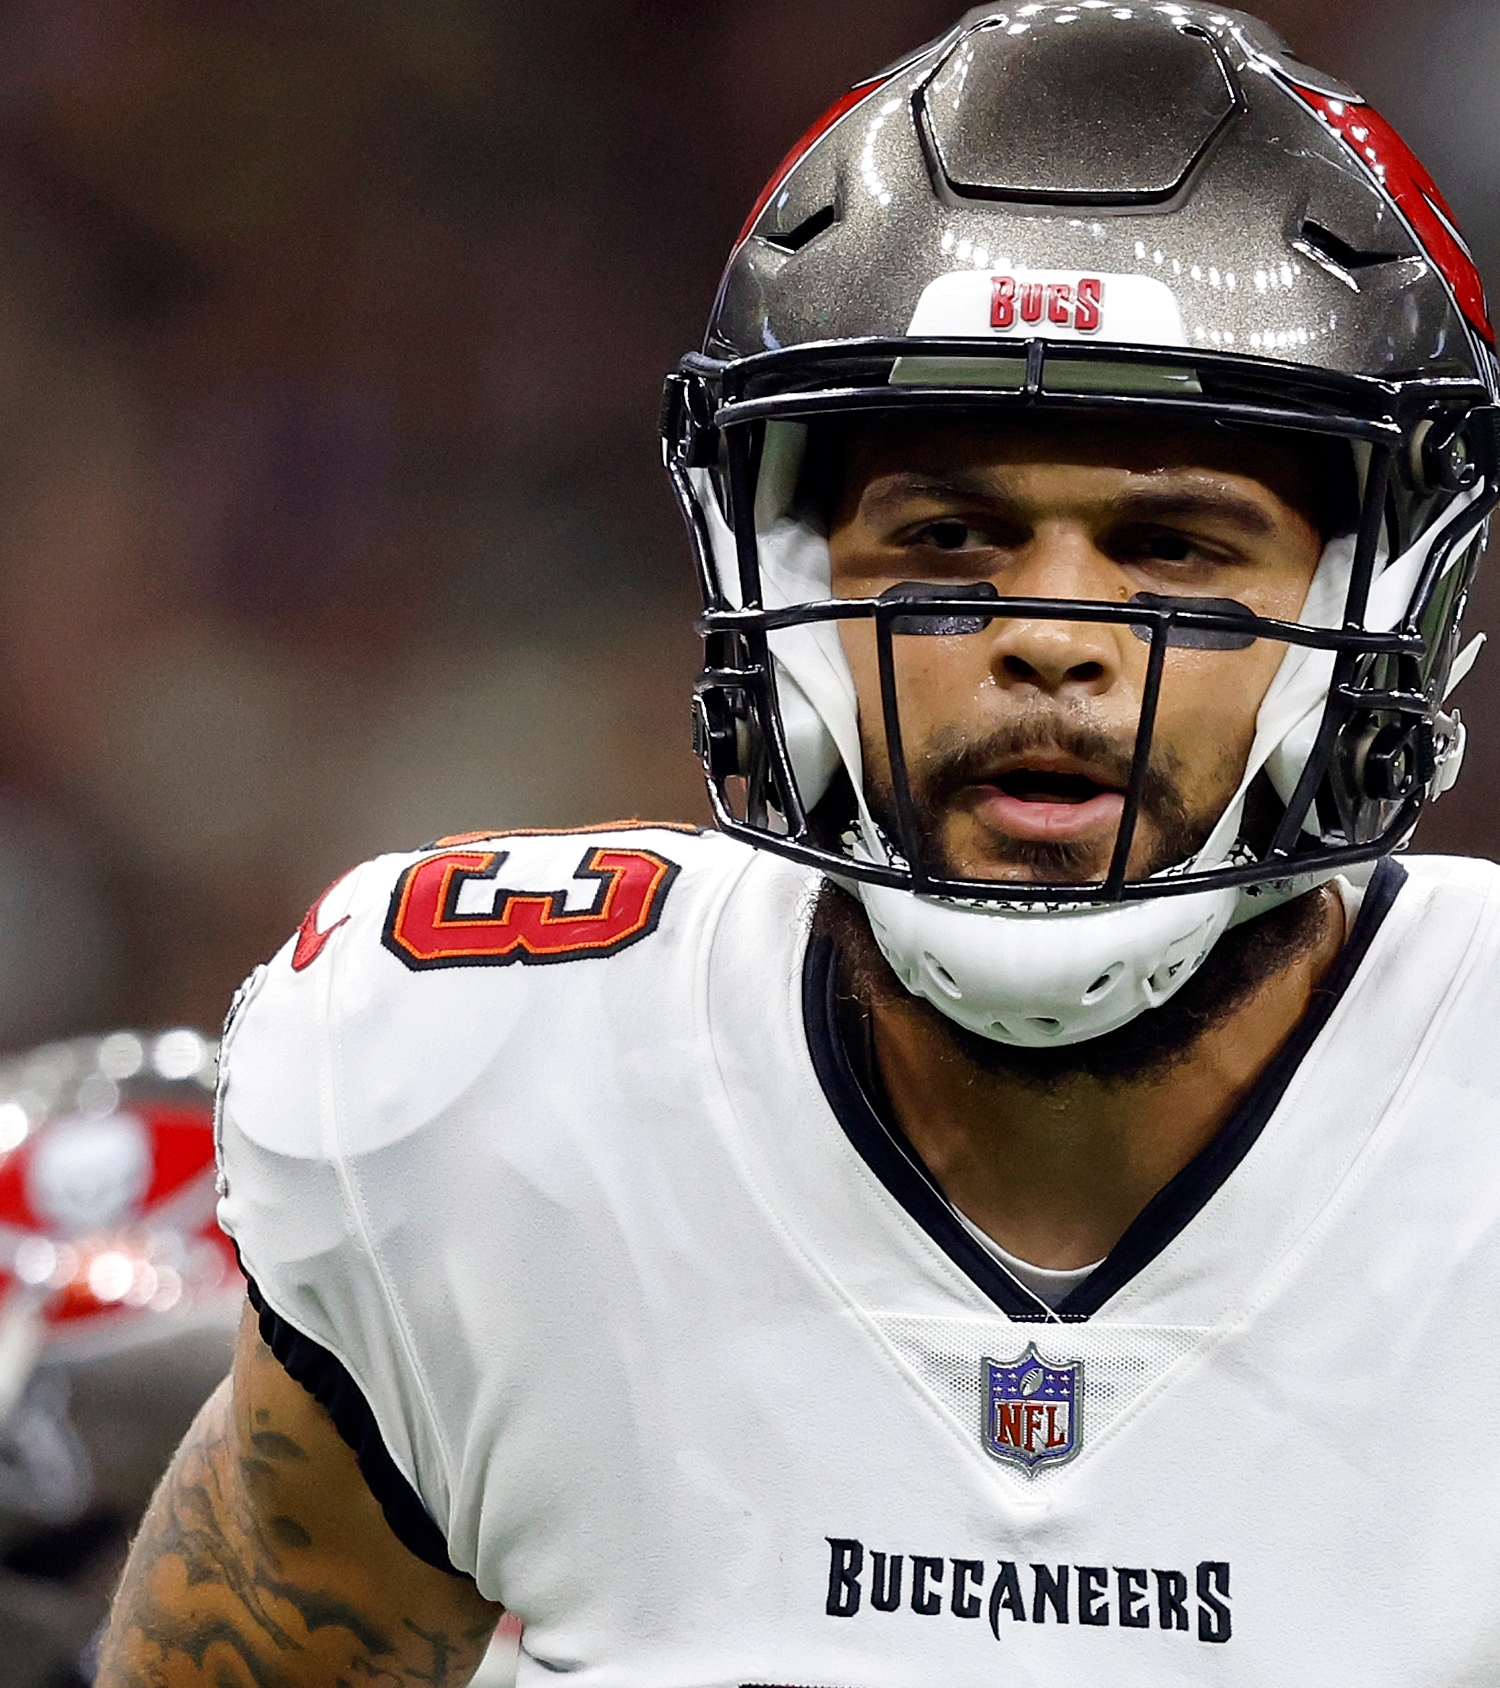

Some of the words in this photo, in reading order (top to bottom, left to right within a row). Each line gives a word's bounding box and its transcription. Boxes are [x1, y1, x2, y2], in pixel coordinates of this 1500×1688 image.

[989, 276, 1105, 335] BUCS
[381, 817, 706, 972] 3
[993, 1402, 1068, 1453] NFL
[824, 1535, 1233, 1644] BUCCANEERS
